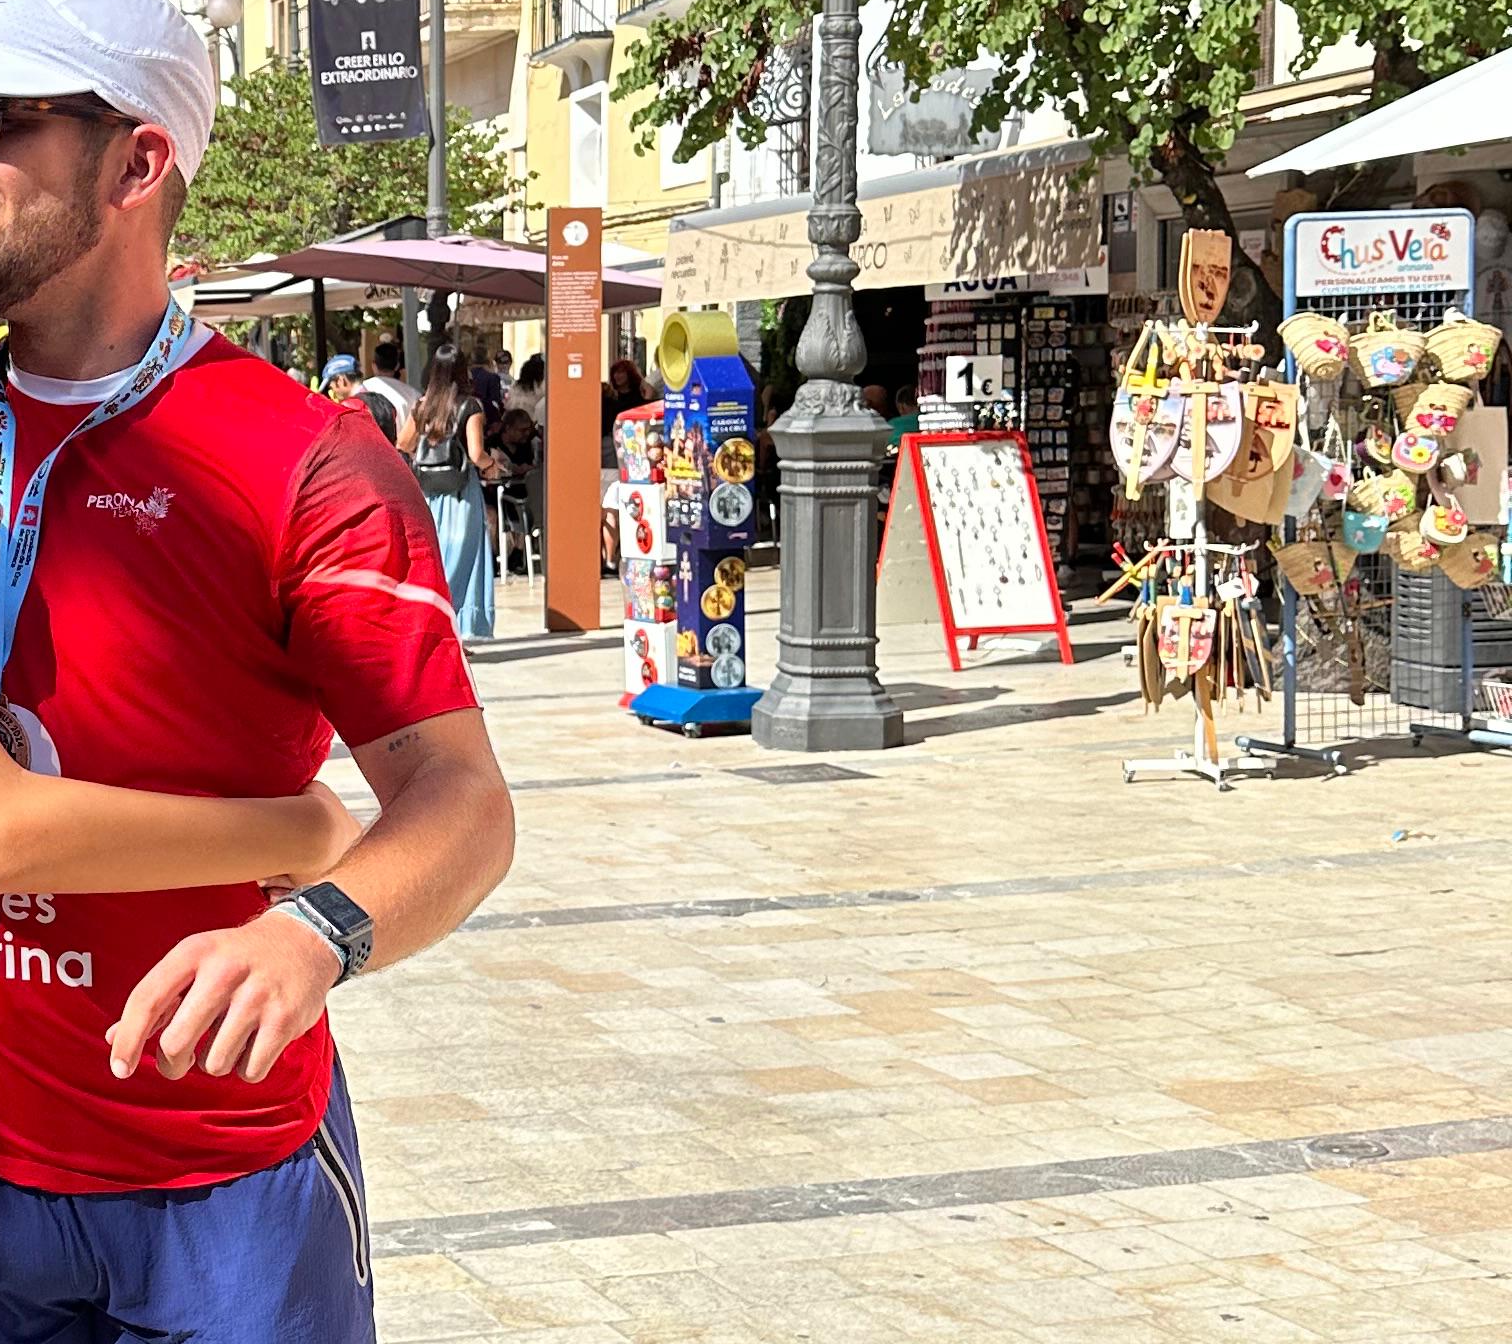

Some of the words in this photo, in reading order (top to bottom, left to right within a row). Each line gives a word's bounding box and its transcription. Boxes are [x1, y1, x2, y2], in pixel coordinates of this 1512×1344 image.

[335, 54, 372, 70] CREER
[372, 53, 387, 67] EN
[388, 52, 405, 66] LO
[320, 66, 418, 85] EXTRAORDINARIO
[1321, 225, 1385, 270] Chus
[1389, 229, 1448, 262] Vera
[957, 362, 974, 396] 1
[981, 379, 993, 396] €
[86, 492, 148, 513] PERONA
